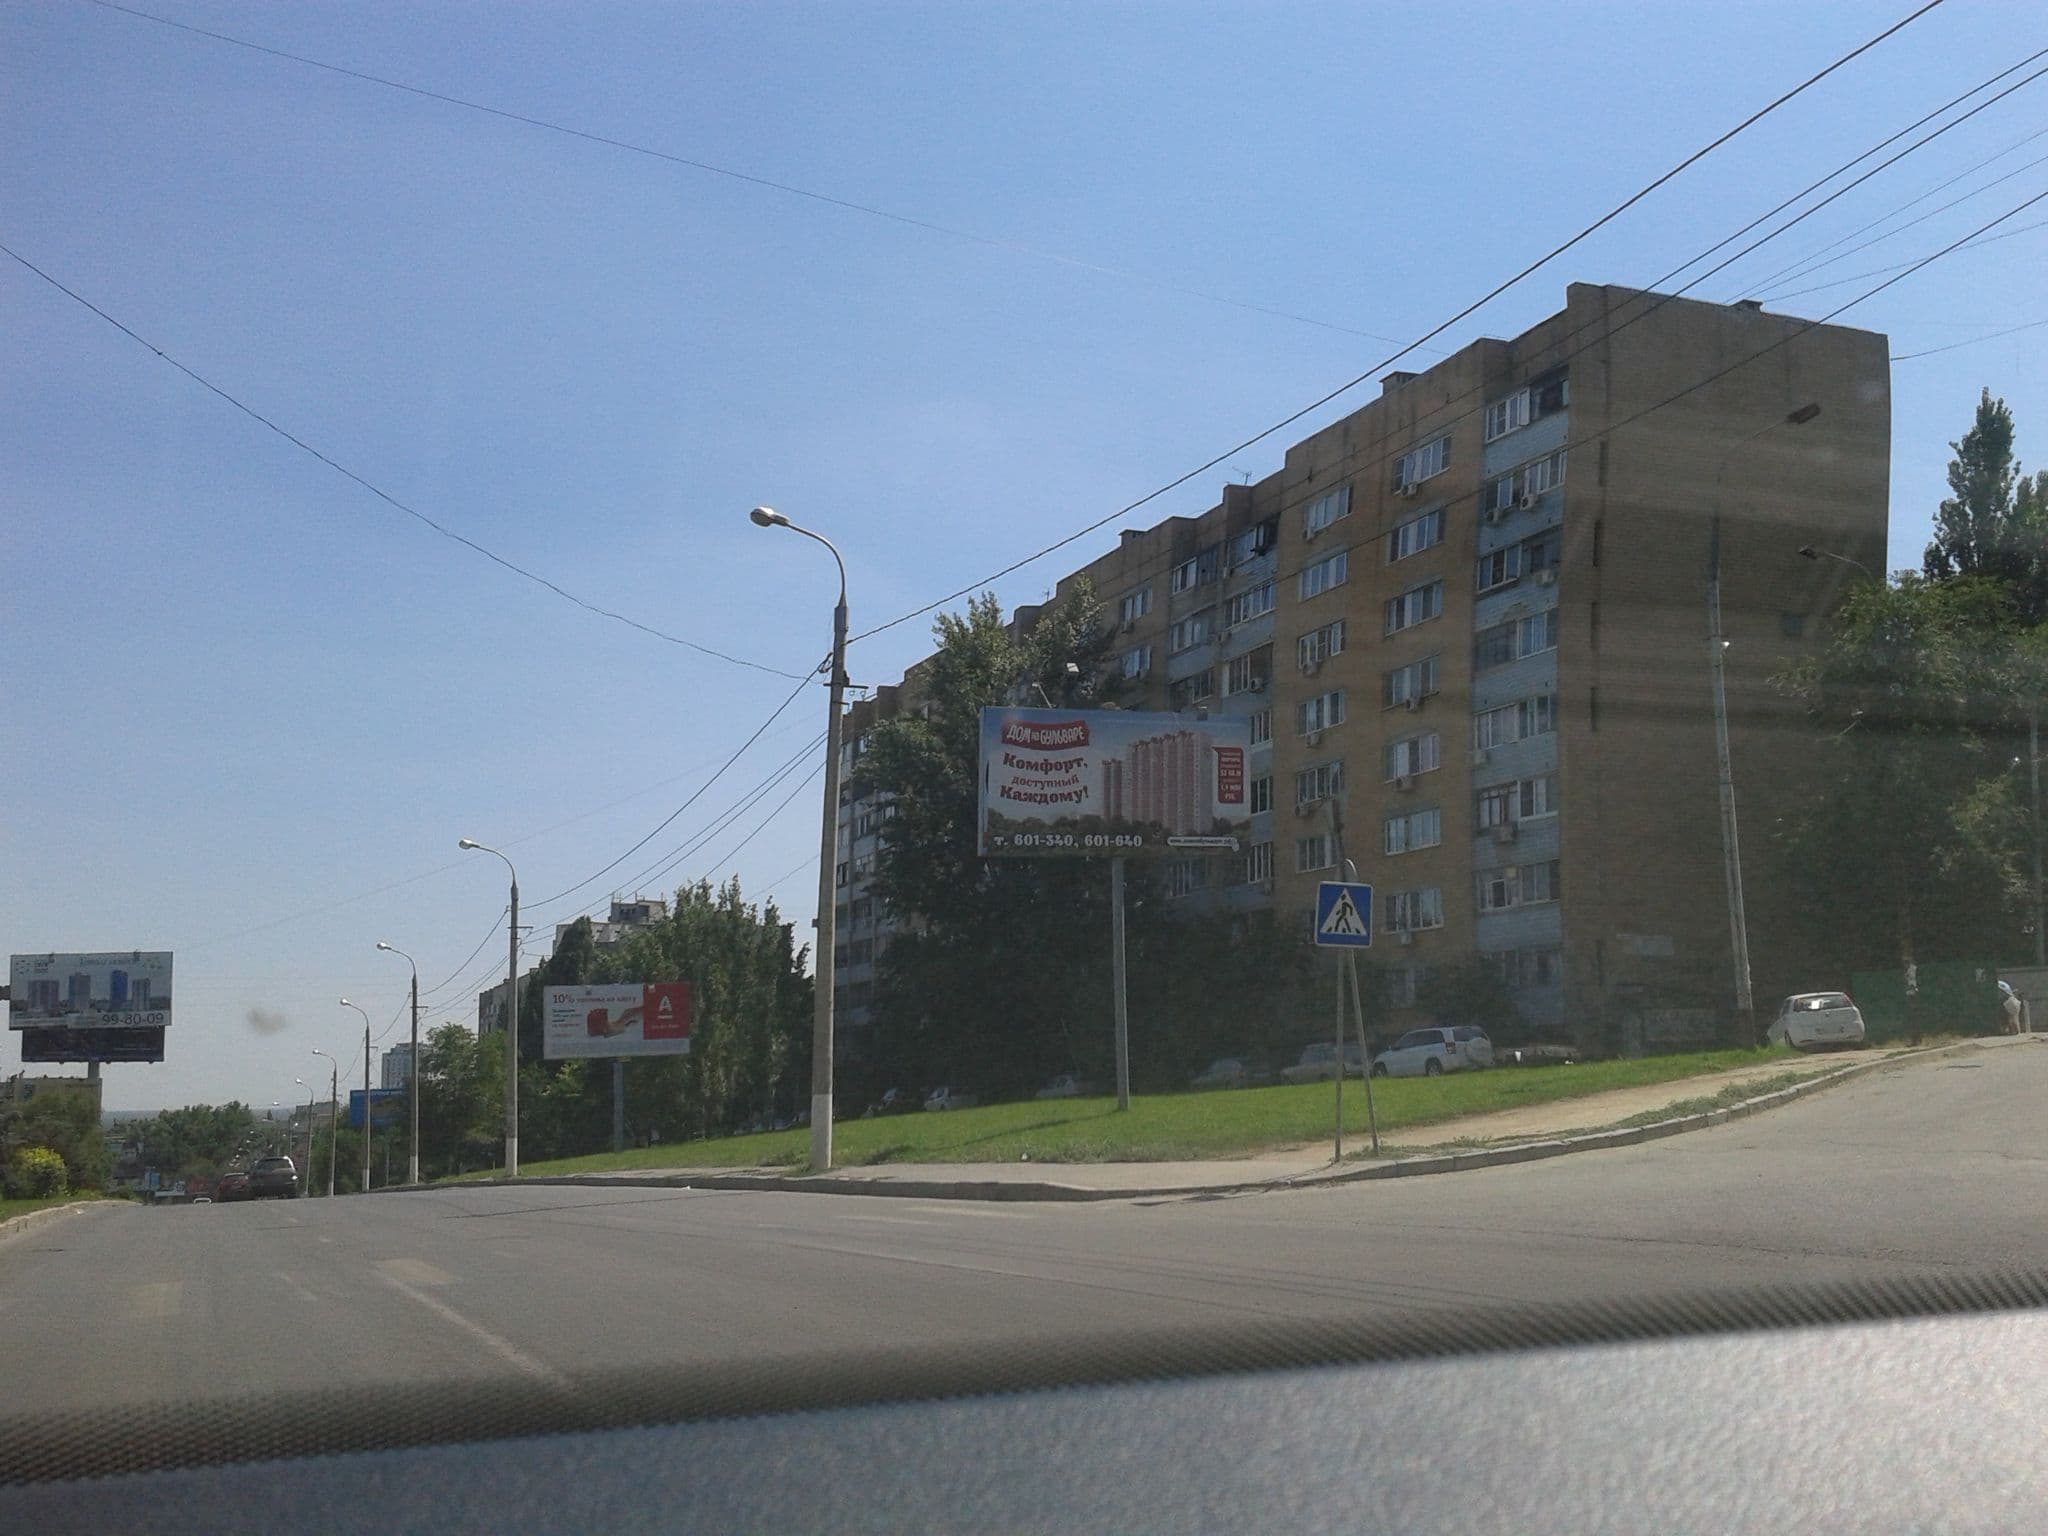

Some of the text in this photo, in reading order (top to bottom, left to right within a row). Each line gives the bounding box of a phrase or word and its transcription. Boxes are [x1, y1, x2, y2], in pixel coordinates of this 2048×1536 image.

[1006, 725, 1031, 743] ДОМ
[1040, 727, 1085, 745] БУЛЬВАРЕ
[1003, 752, 1088, 775] Комфорт,
[1012, 774, 1079, 790] доступный
[1000, 785, 1089, 804] Каждому!
[102, 1013, 164, 1025] 99-80-09
